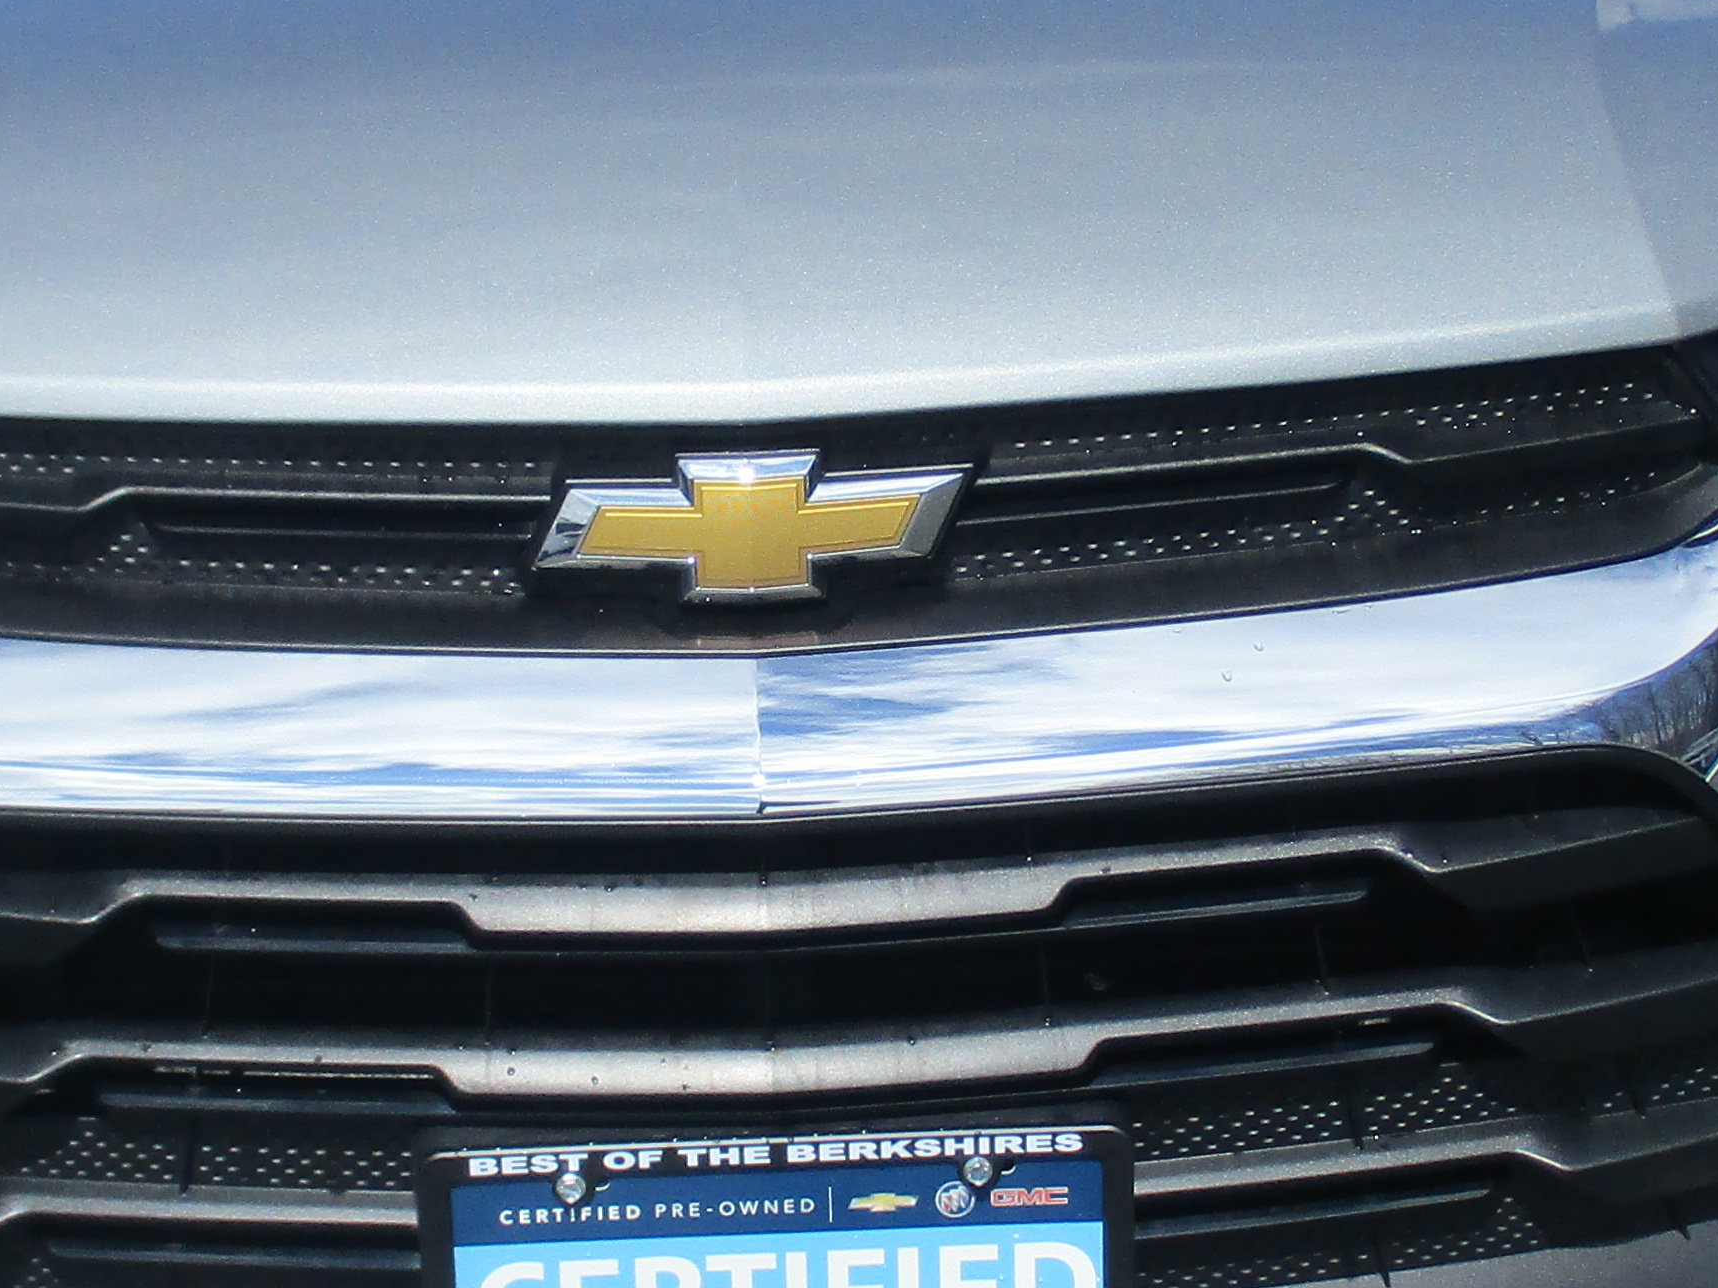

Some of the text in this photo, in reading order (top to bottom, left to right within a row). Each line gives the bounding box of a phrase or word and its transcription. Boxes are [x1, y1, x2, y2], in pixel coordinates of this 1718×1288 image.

[468, 1133, 1084, 1177] BEST OF THE BERKSHIRES
[990, 1186, 1069, 1207] GMC
[499, 1197, 816, 1226] CERTIFIED PRE-OWNED
